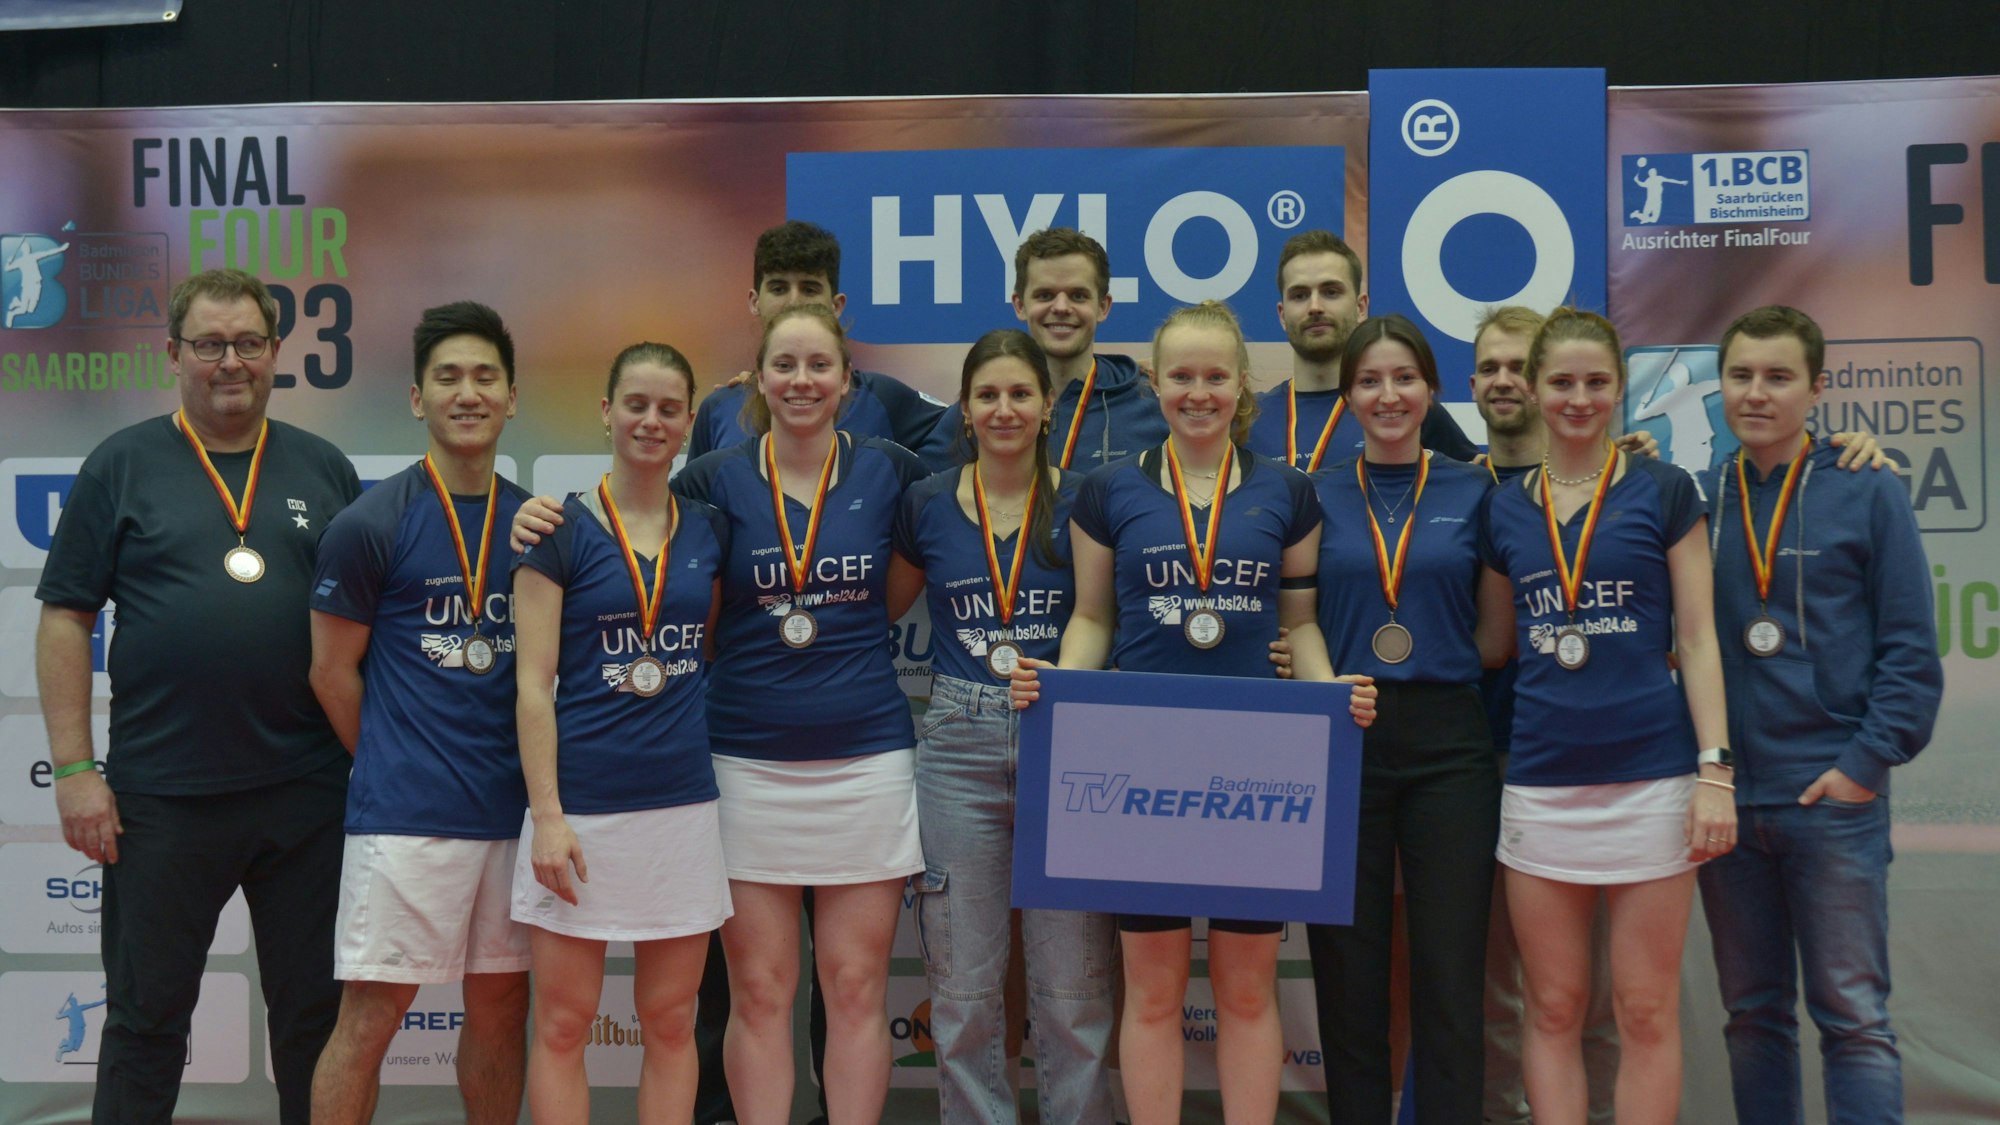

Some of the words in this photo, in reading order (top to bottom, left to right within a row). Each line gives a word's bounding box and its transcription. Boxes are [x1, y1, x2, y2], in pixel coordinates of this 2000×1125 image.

[133, 136, 306, 207] FINAL
[1700, 156, 1803, 187] 1.BCB
[1710, 205, 1804, 219] Bischmisheim
[1717, 192, 1803, 205] Saarbrücken
[189, 207, 349, 279] FOUR
[1622, 229, 1719, 250] Ausrichter
[1724, 227, 1811, 247] FinalFour
[80, 286, 161, 319] LIGA
[1822, 360, 1962, 389] adminton
[1143, 542, 1186, 554] zugunsten
[1146, 559, 1270, 587] UNCEF
[950, 590, 1063, 620] UNCEF
[1184, 594, 1262, 612] www.bsl24.de
[1525, 581, 1634, 617] UNCEF
[1209, 776, 1317, 796] Badminton
[1121, 788, 1312, 823] REFRATH
[46, 921, 83, 934] Autos
[386, 1055, 430, 1065] unsere
